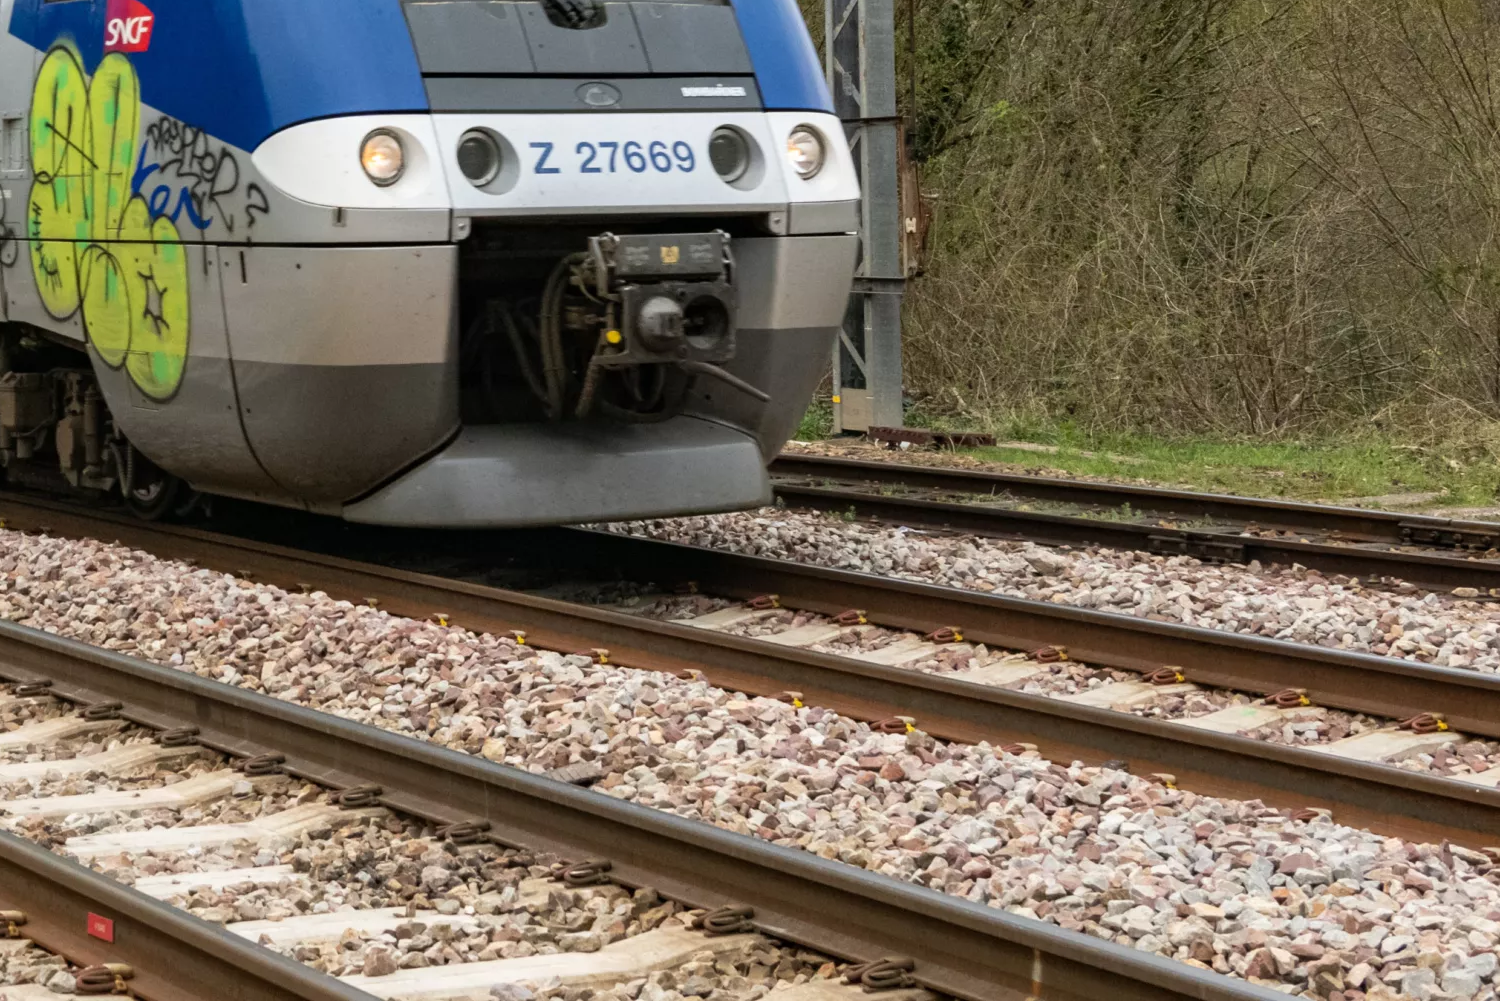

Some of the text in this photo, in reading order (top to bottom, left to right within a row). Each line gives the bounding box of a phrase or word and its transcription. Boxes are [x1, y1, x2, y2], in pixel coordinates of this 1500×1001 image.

[105, 15, 153, 46] SNCF
[528, 140, 696, 174] Z 27669
